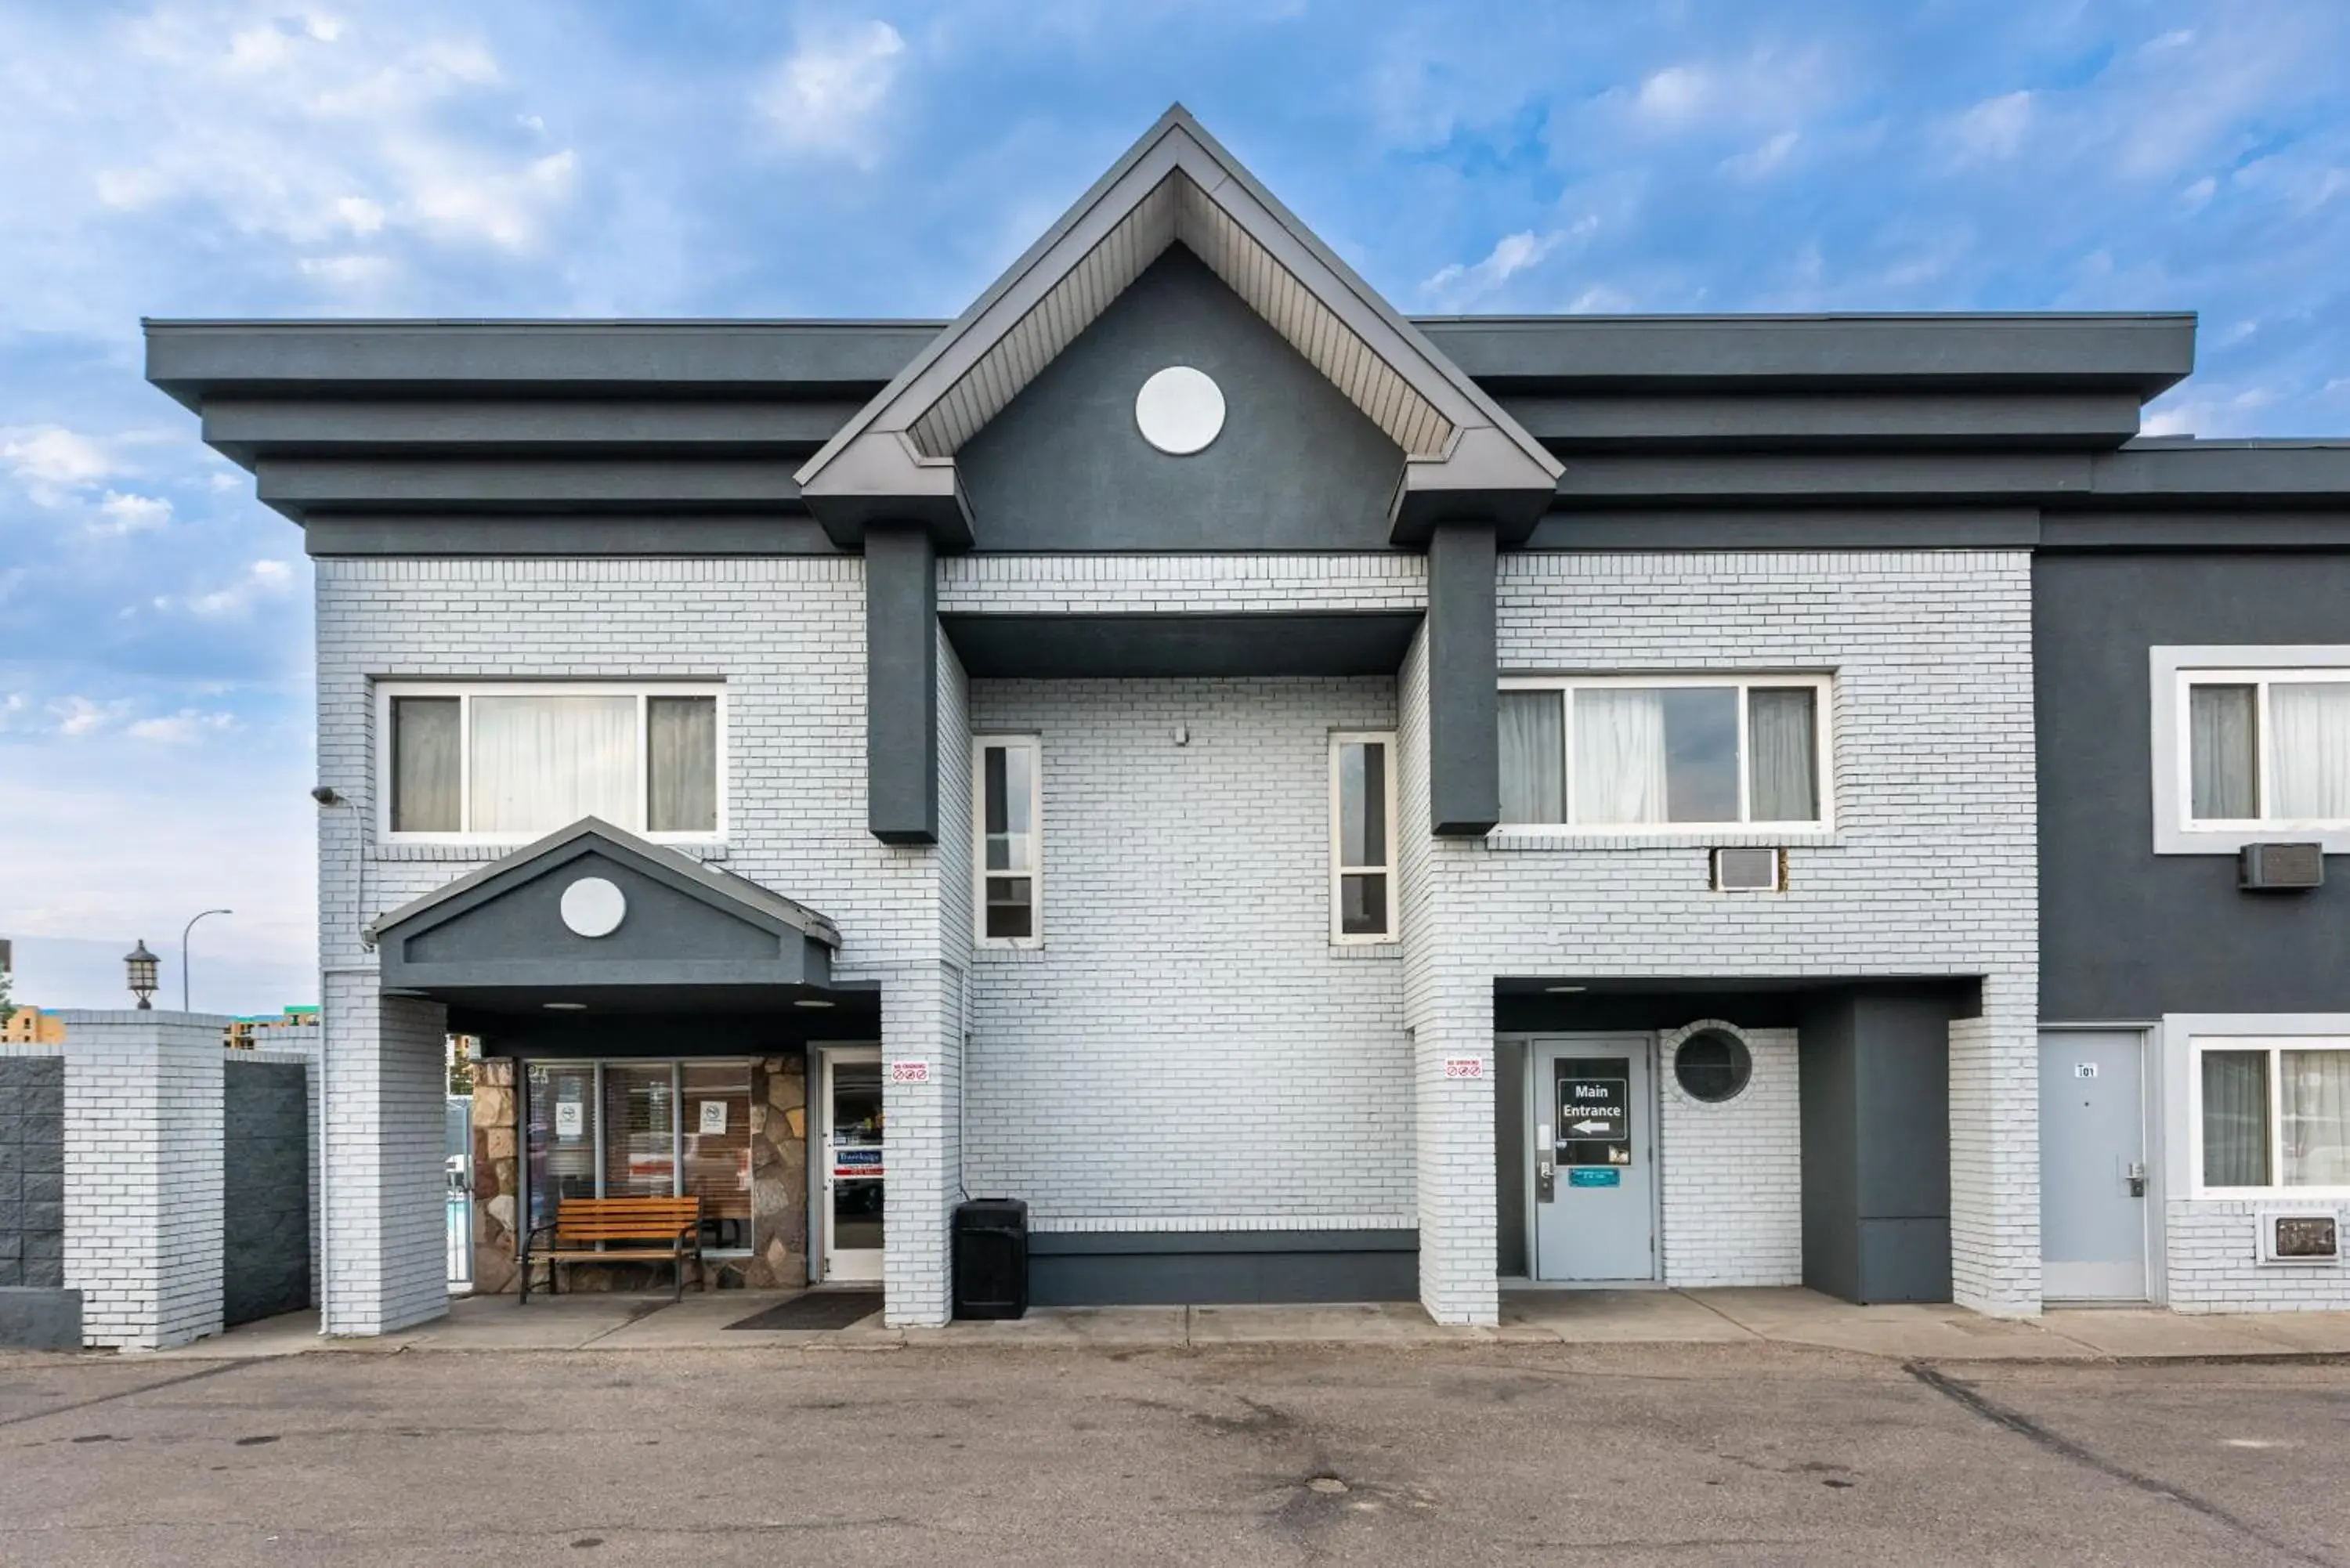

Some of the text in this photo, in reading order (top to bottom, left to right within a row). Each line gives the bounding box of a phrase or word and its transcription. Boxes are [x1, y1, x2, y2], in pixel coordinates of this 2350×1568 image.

[2078, 1064, 2094, 1077] 101
[1575, 1084, 1608, 1097] Main
[1564, 1104, 1622, 1116] Entrance
